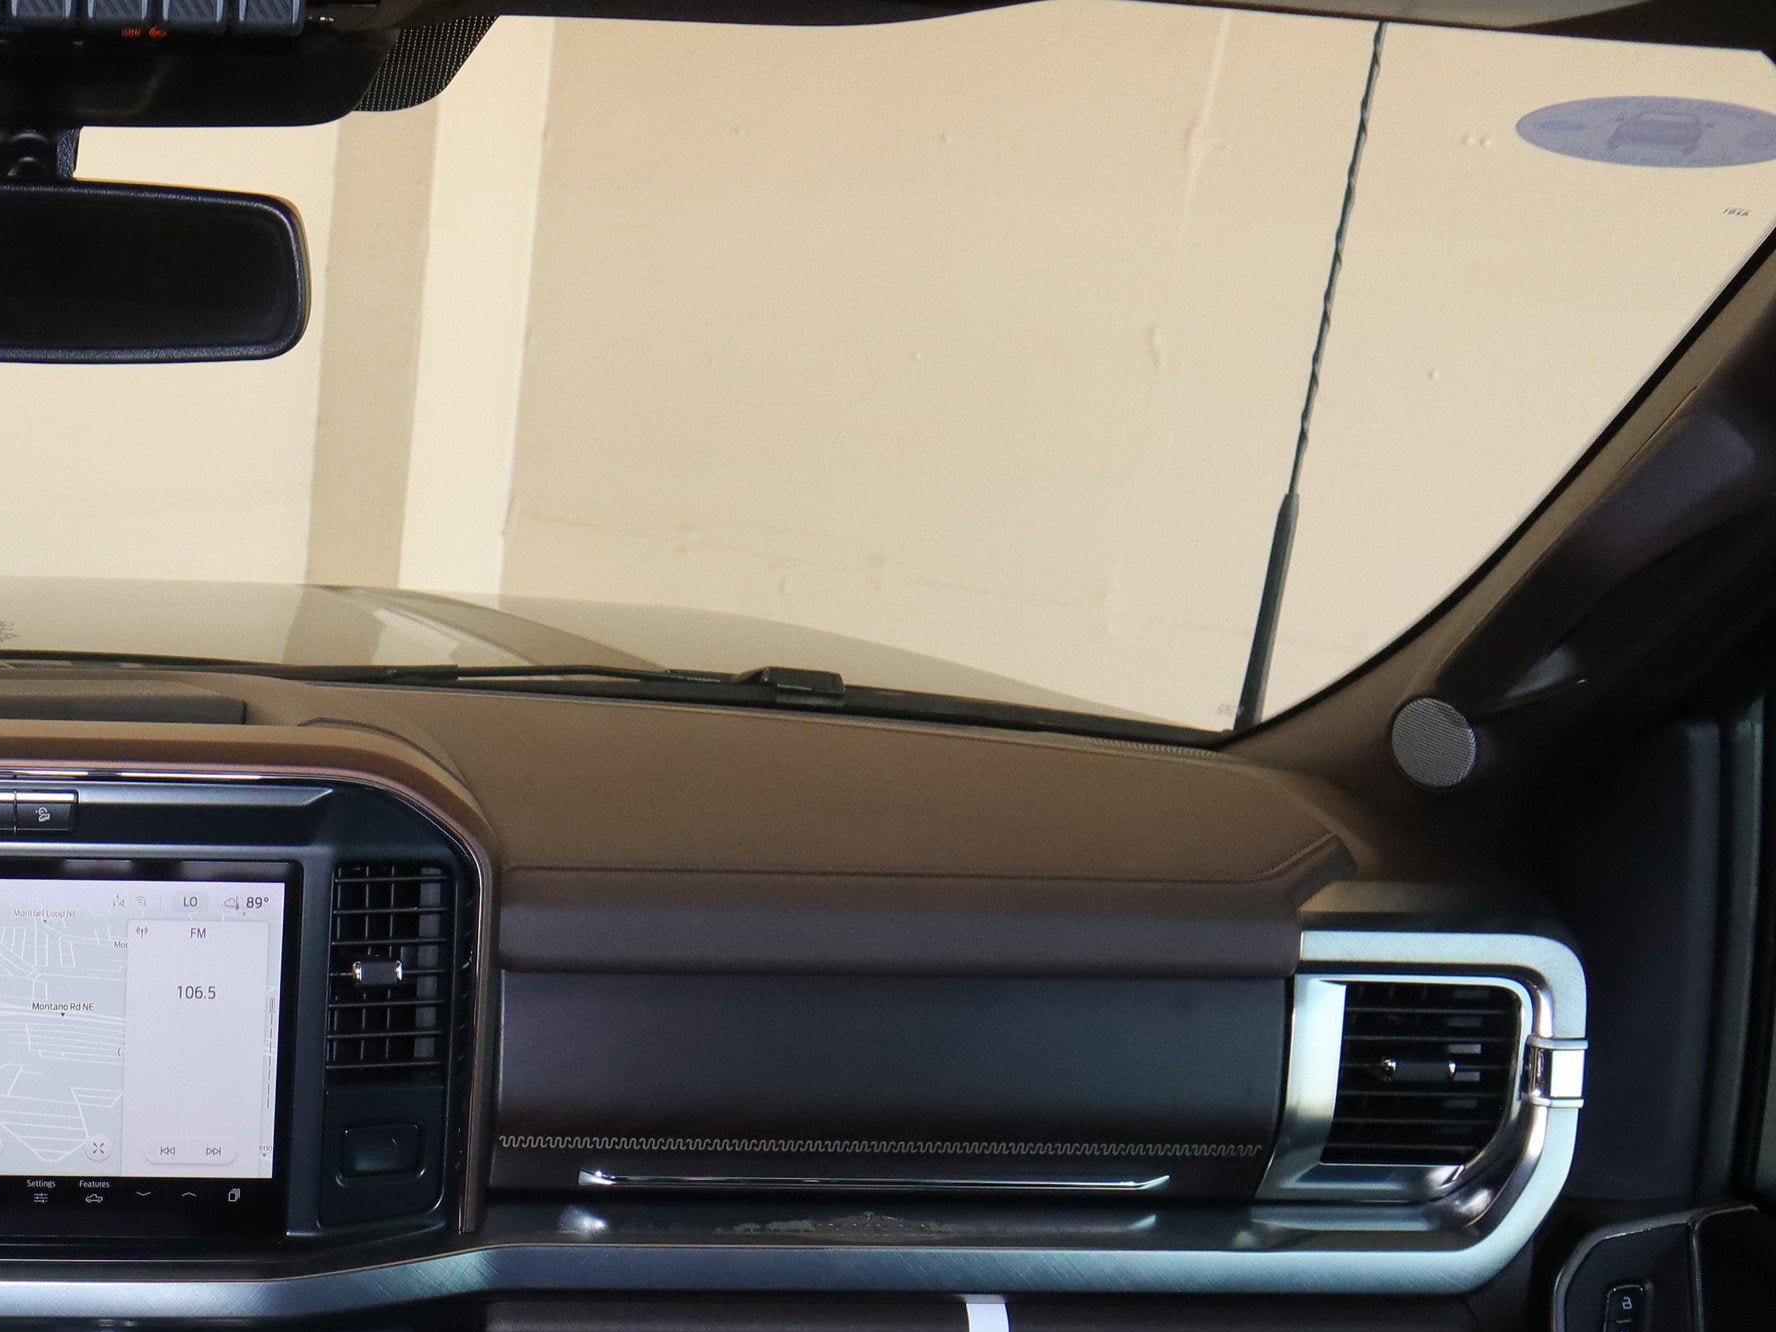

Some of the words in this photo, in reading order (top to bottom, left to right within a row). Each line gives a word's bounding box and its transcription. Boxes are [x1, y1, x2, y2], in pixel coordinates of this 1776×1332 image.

[183, 896, 198, 908] LO
[246, 896, 270, 909] 89°
[13, 909, 45, 917] Montbel
[46, 909, 66, 918] Loop
[66, 910, 78, 918] NE
[190, 927, 207, 939] FM
[176, 985, 217, 1000] 106.5
[31, 1002, 69, 1011] Montano
[69, 1003, 81, 1011] Rd
[81, 1003, 93, 1011] NE
[26, 1179, 56, 1189] Settings
[79, 1180, 110, 1188] Features
